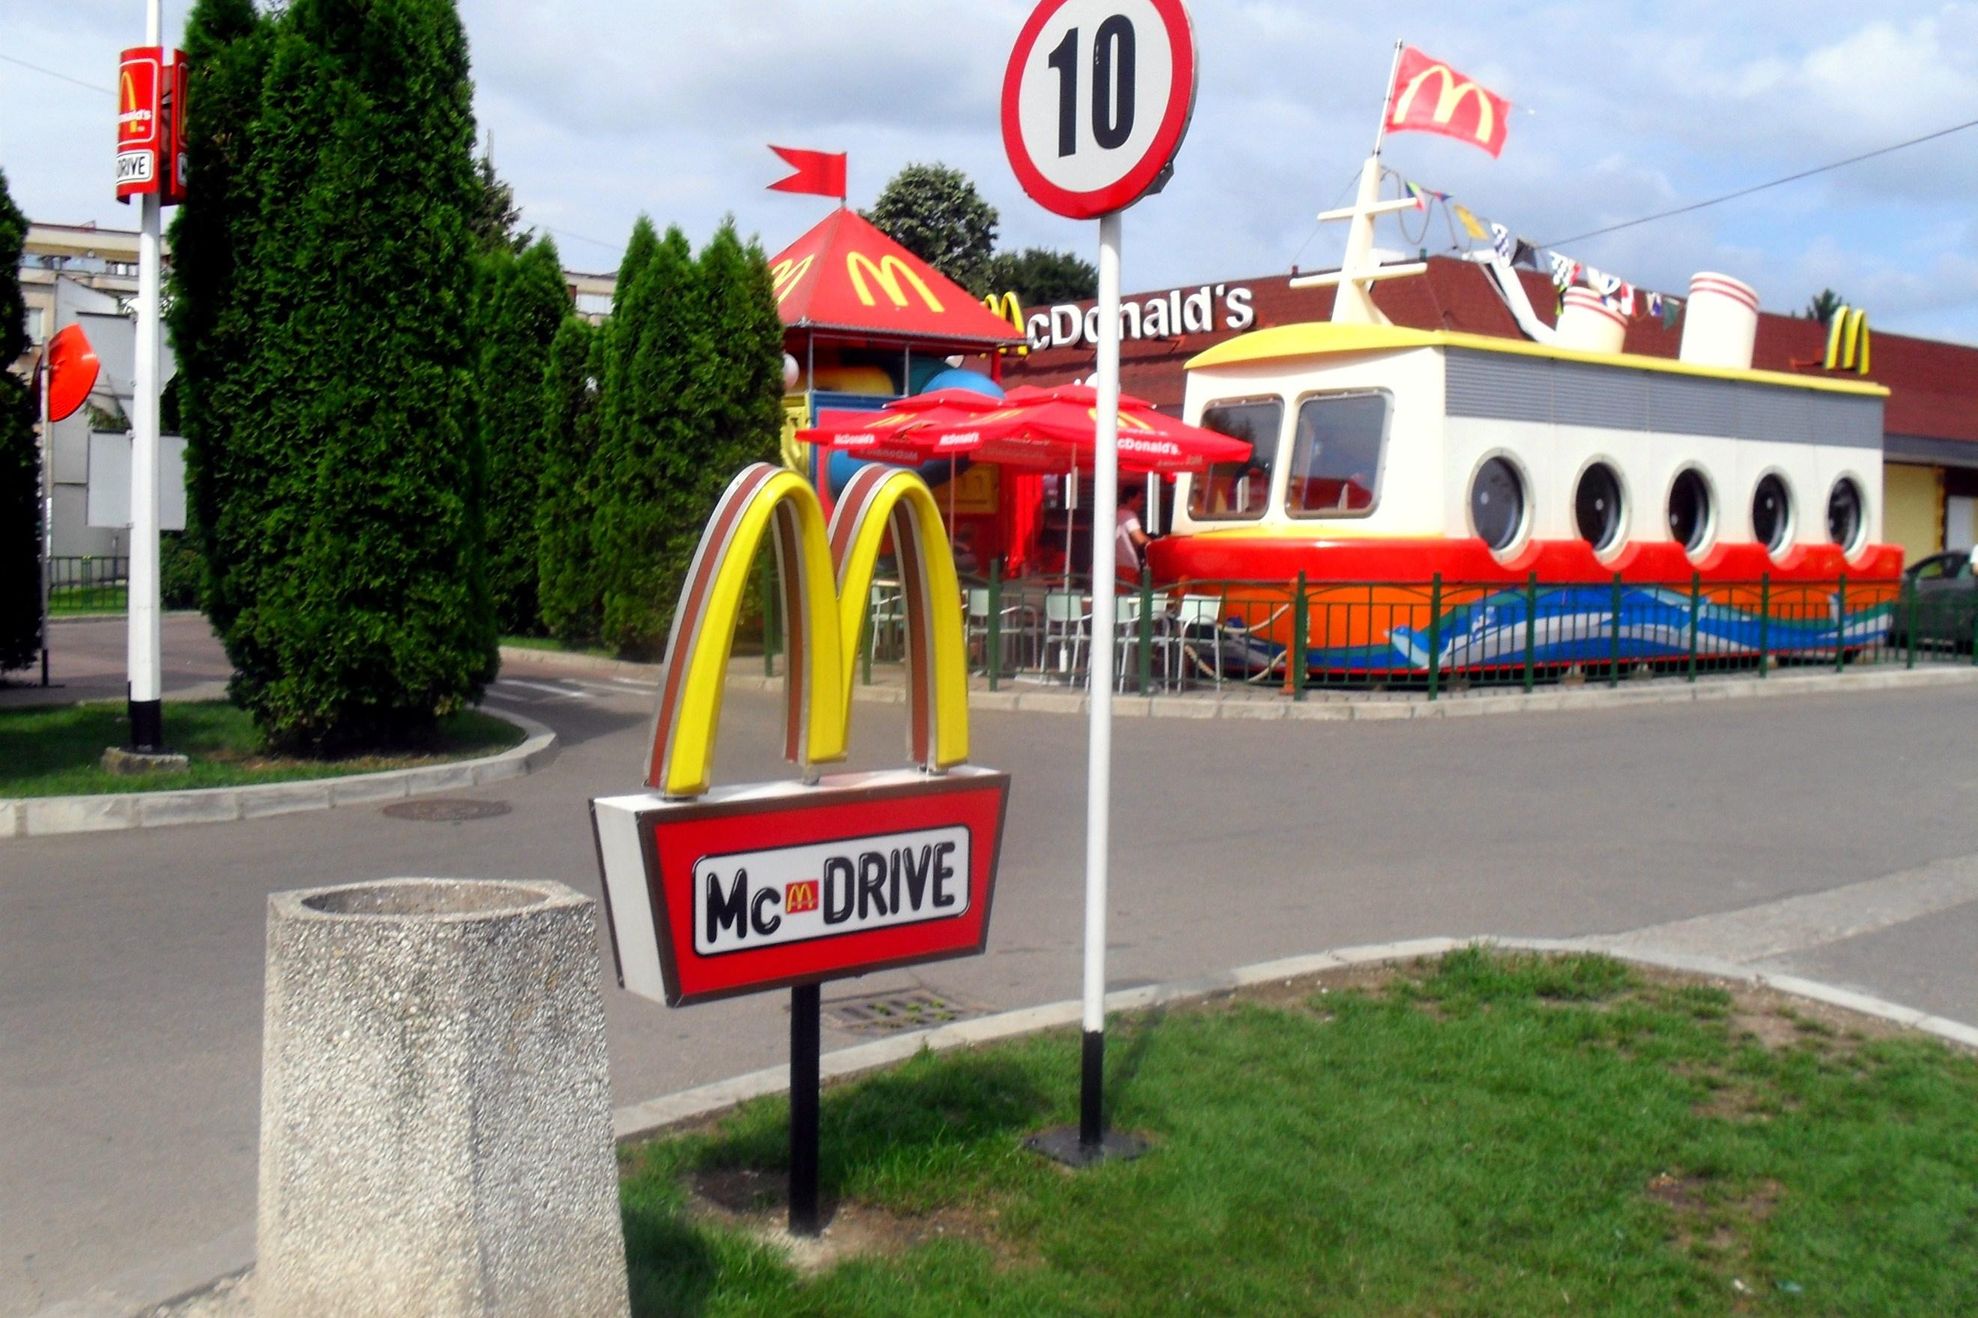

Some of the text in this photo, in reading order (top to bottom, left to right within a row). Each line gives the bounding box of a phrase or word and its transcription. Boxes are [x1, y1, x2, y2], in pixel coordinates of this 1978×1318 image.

[1048, 14, 1136, 158] 10
[1117, 437, 1180, 456] cDonald's
[823, 841, 956, 925] DRIVE
